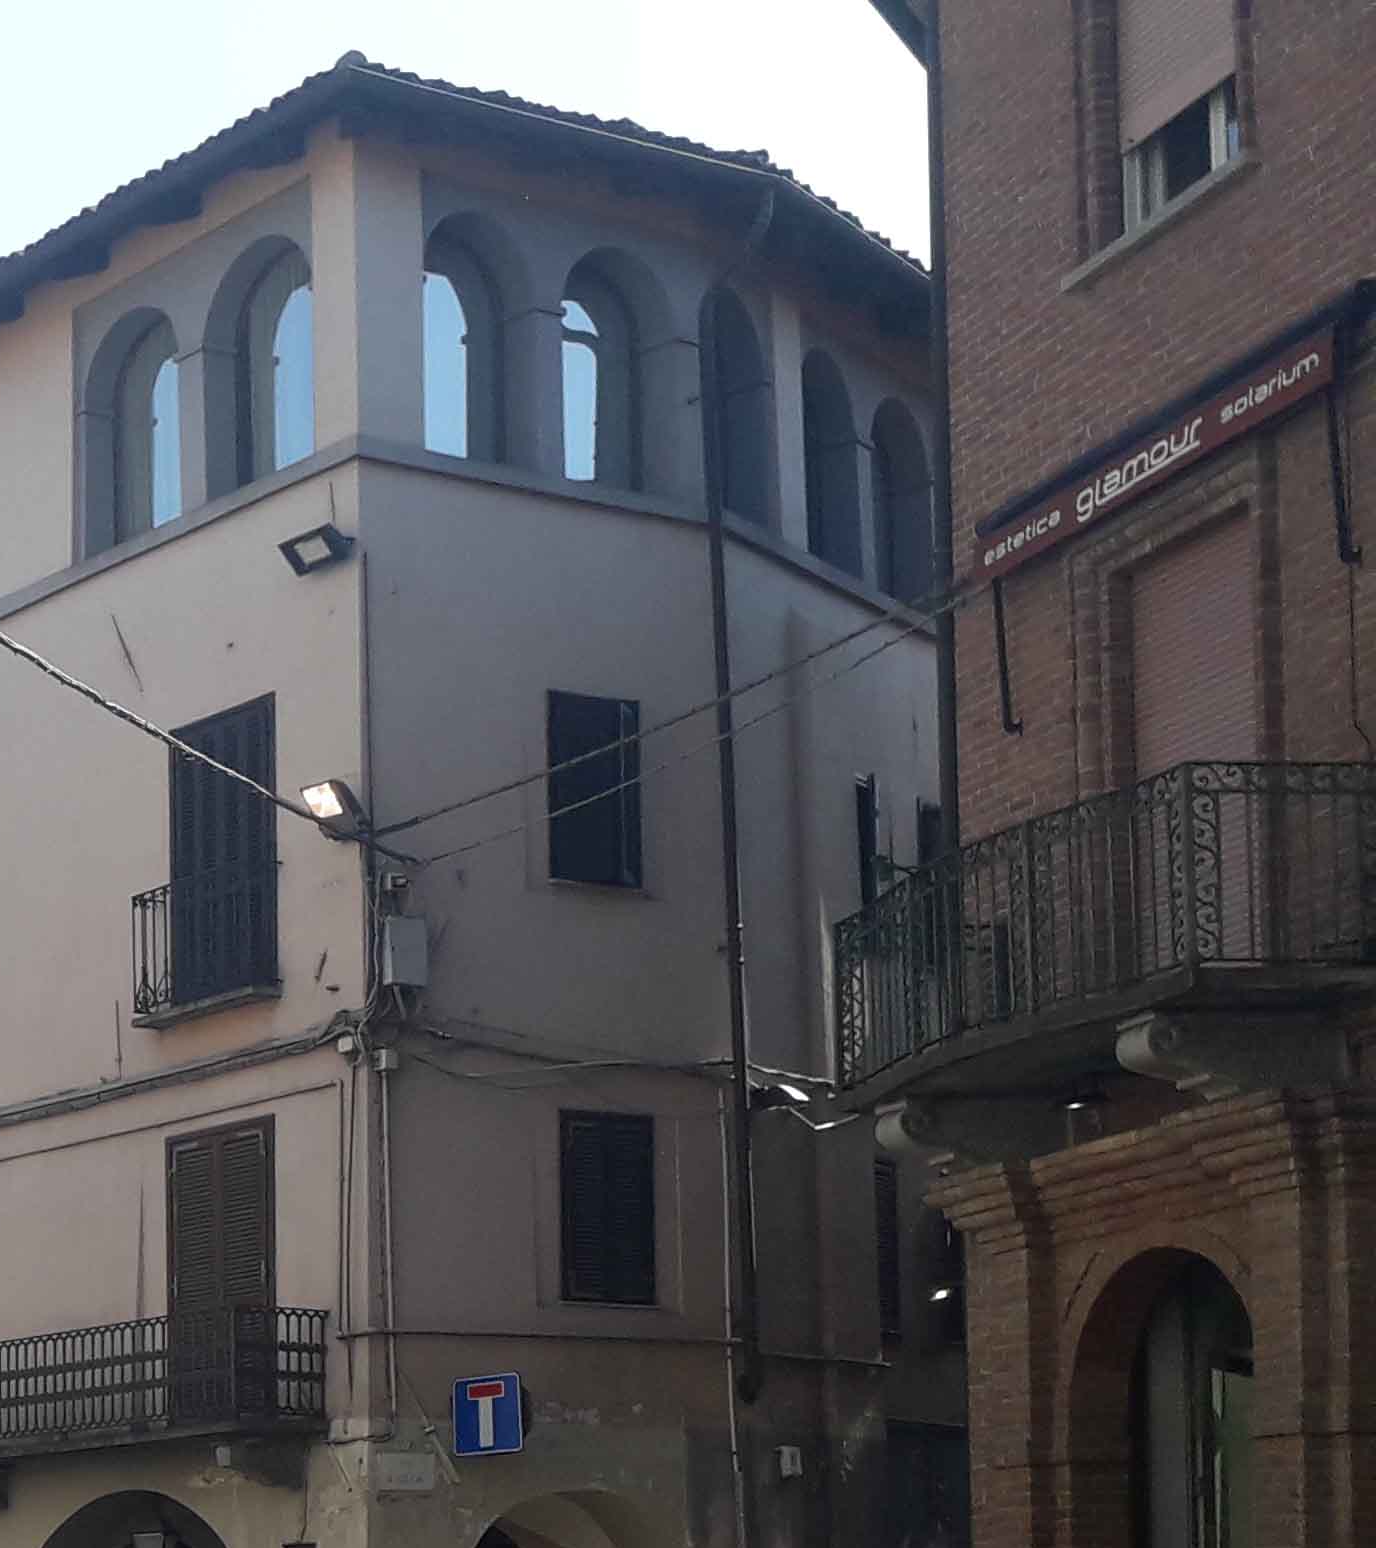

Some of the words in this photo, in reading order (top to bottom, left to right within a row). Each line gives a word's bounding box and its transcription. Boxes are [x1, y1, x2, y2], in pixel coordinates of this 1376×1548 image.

[984, 508, 1061, 566] estetica
[1075, 417, 1203, 523] glamour
[1220, 351, 1320, 425] solarium
